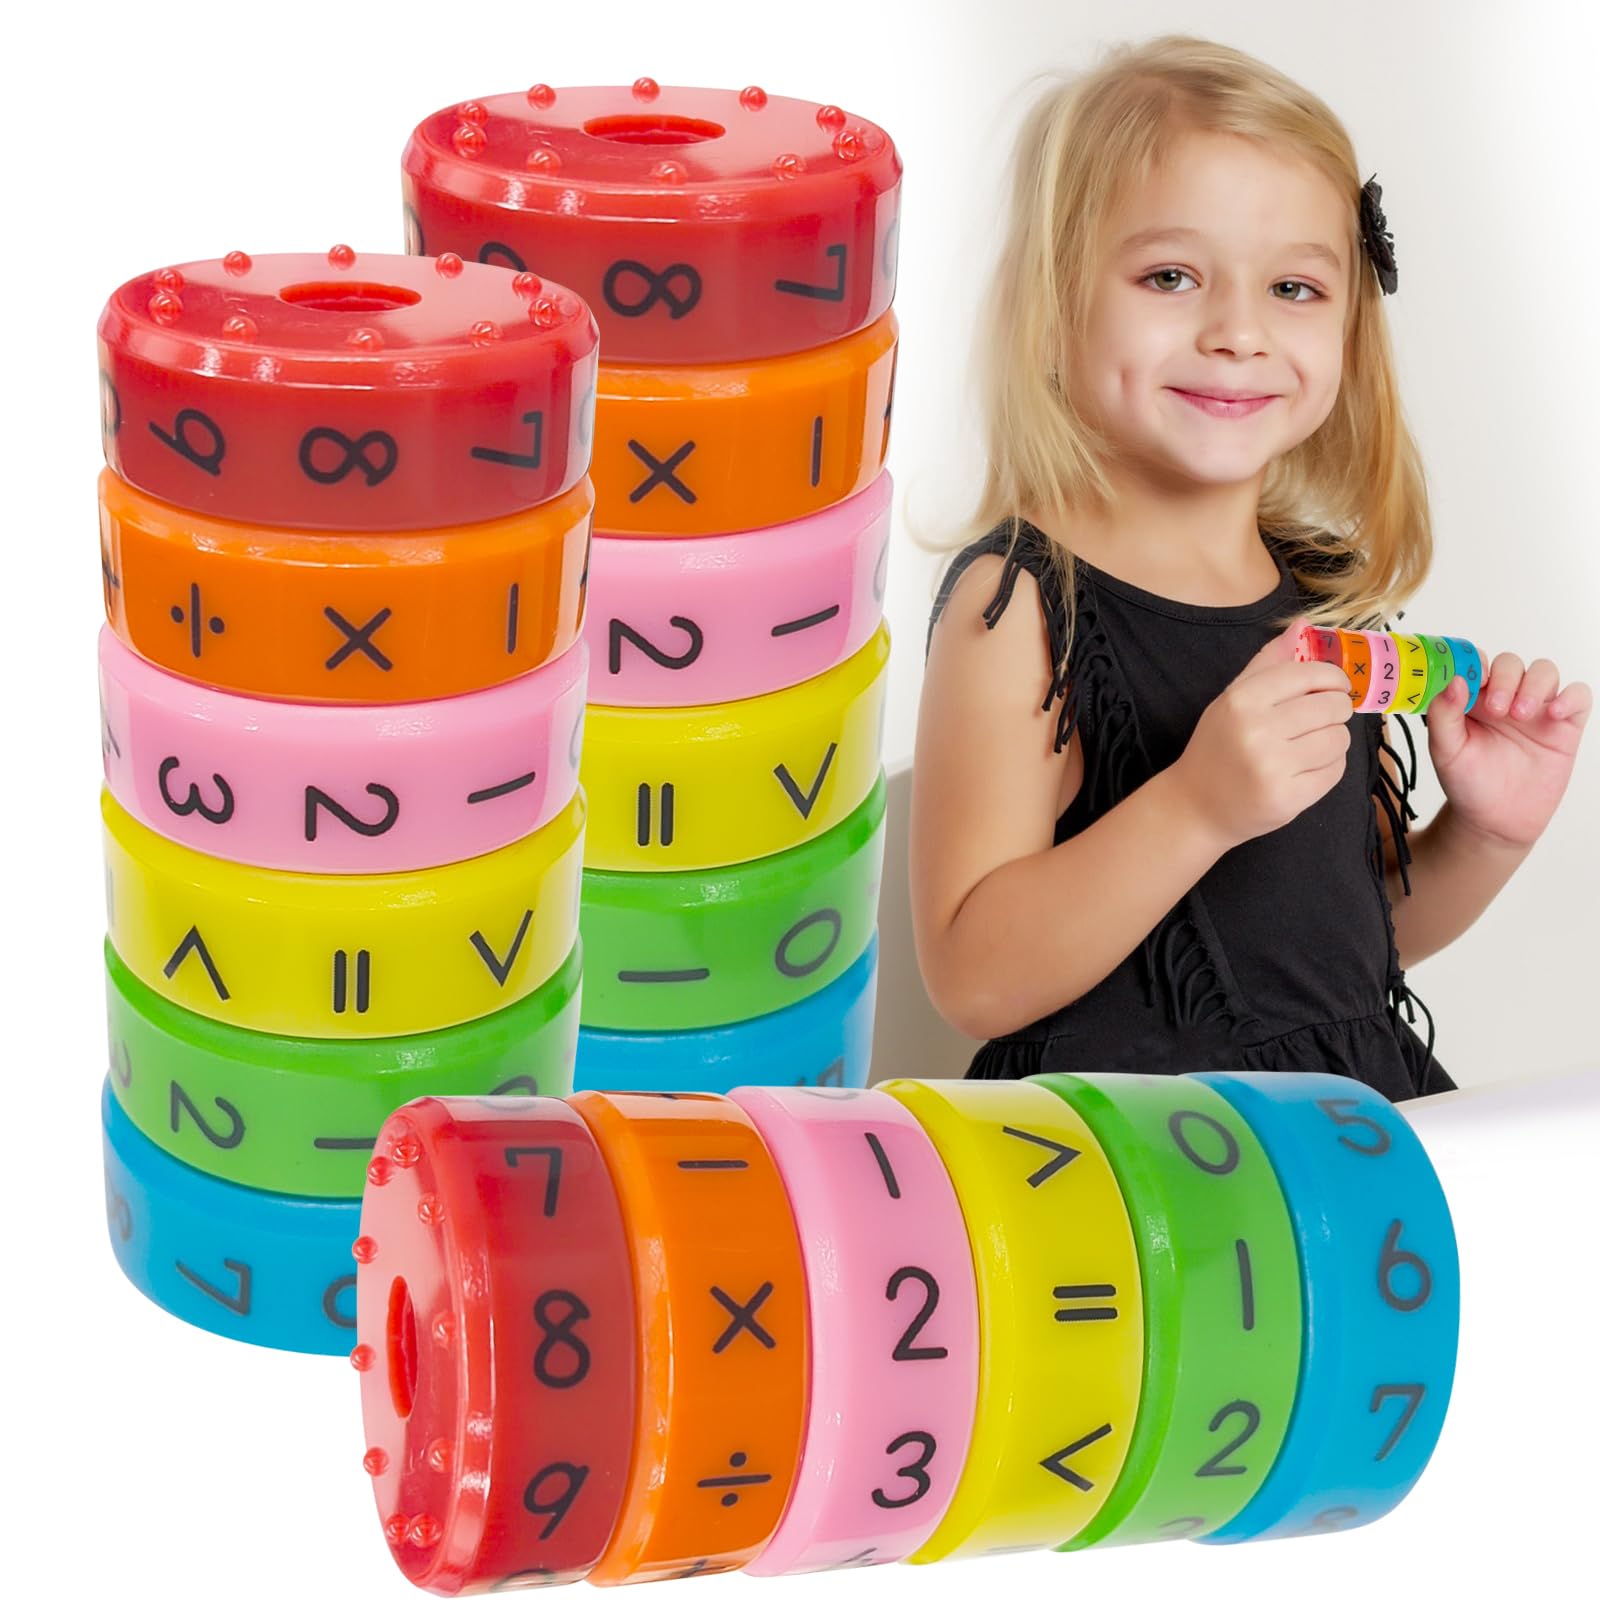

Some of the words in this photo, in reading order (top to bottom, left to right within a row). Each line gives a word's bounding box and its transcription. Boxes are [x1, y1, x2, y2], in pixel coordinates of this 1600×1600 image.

[603, 260, 701, 320] 8
[775, 244, 847, 302] 7
[149, 408, 226, 477] 9
[299, 427, 397, 487] 8
[470, 411, 543, 469] 7
[608, 615, 704, 675] 2
[1383, 662, 1395, 680] 2
[1377, 690, 1391, 705] 3
[158, 756, 235, 825] 3
[304, 782, 400, 842] 2
[170, 1080, 246, 1150] 2
[504, 1147, 563, 1218] 7
[1168, 1111, 1240, 1176] 0
[1316, 1099, 1392, 1157] 5
[175, 1259, 252, 1317] 7
[533, 1290, 591, 1389] 8
[885, 1266, 949, 1362] 2
[1377, 1219, 1432, 1313] 6
[523, 1462, 590, 1541] 9
[871, 1430, 937, 1509] 3
[1194, 1399, 1261, 1478] 2
[1369, 1383, 1426, 1462] 7
